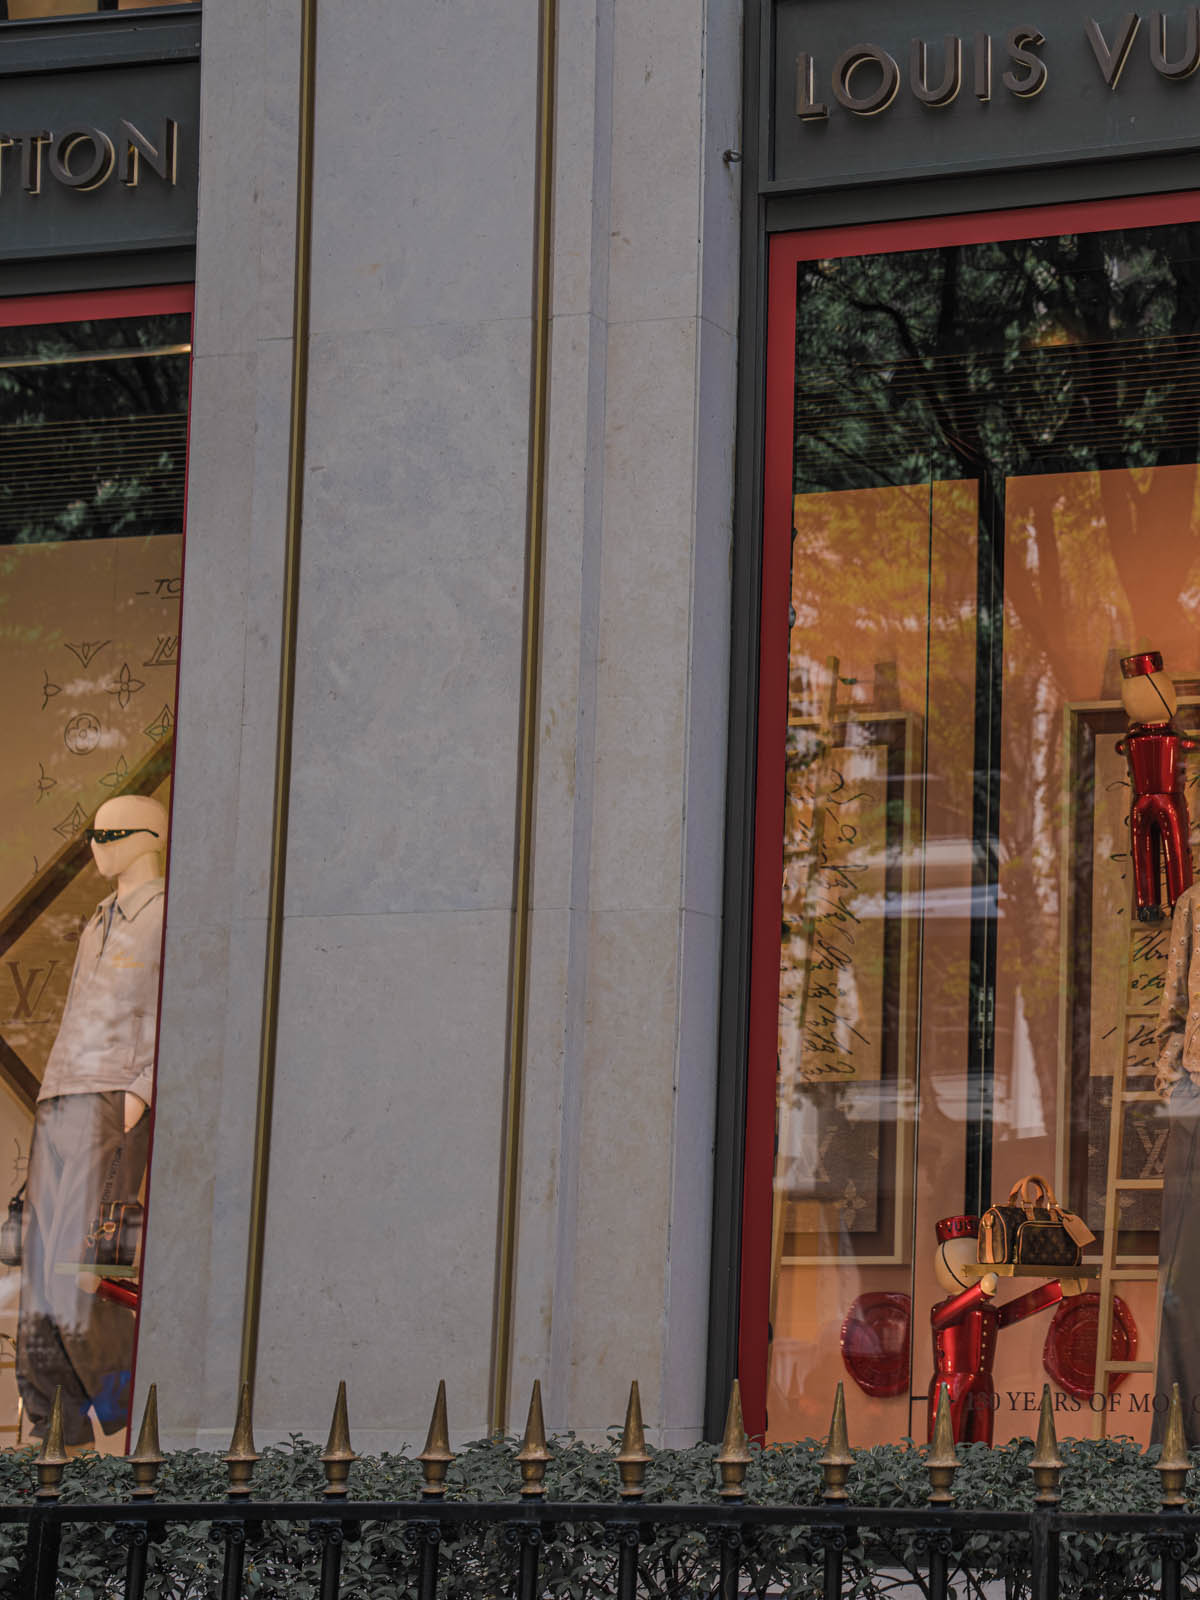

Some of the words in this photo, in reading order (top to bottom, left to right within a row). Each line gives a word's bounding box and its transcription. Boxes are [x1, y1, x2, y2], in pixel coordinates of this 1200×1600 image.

[795, 24, 1048, 121] LOUIS
[1006, 1391, 1082, 1412] YERS
[1089, 1391, 1121, 1413] OF
